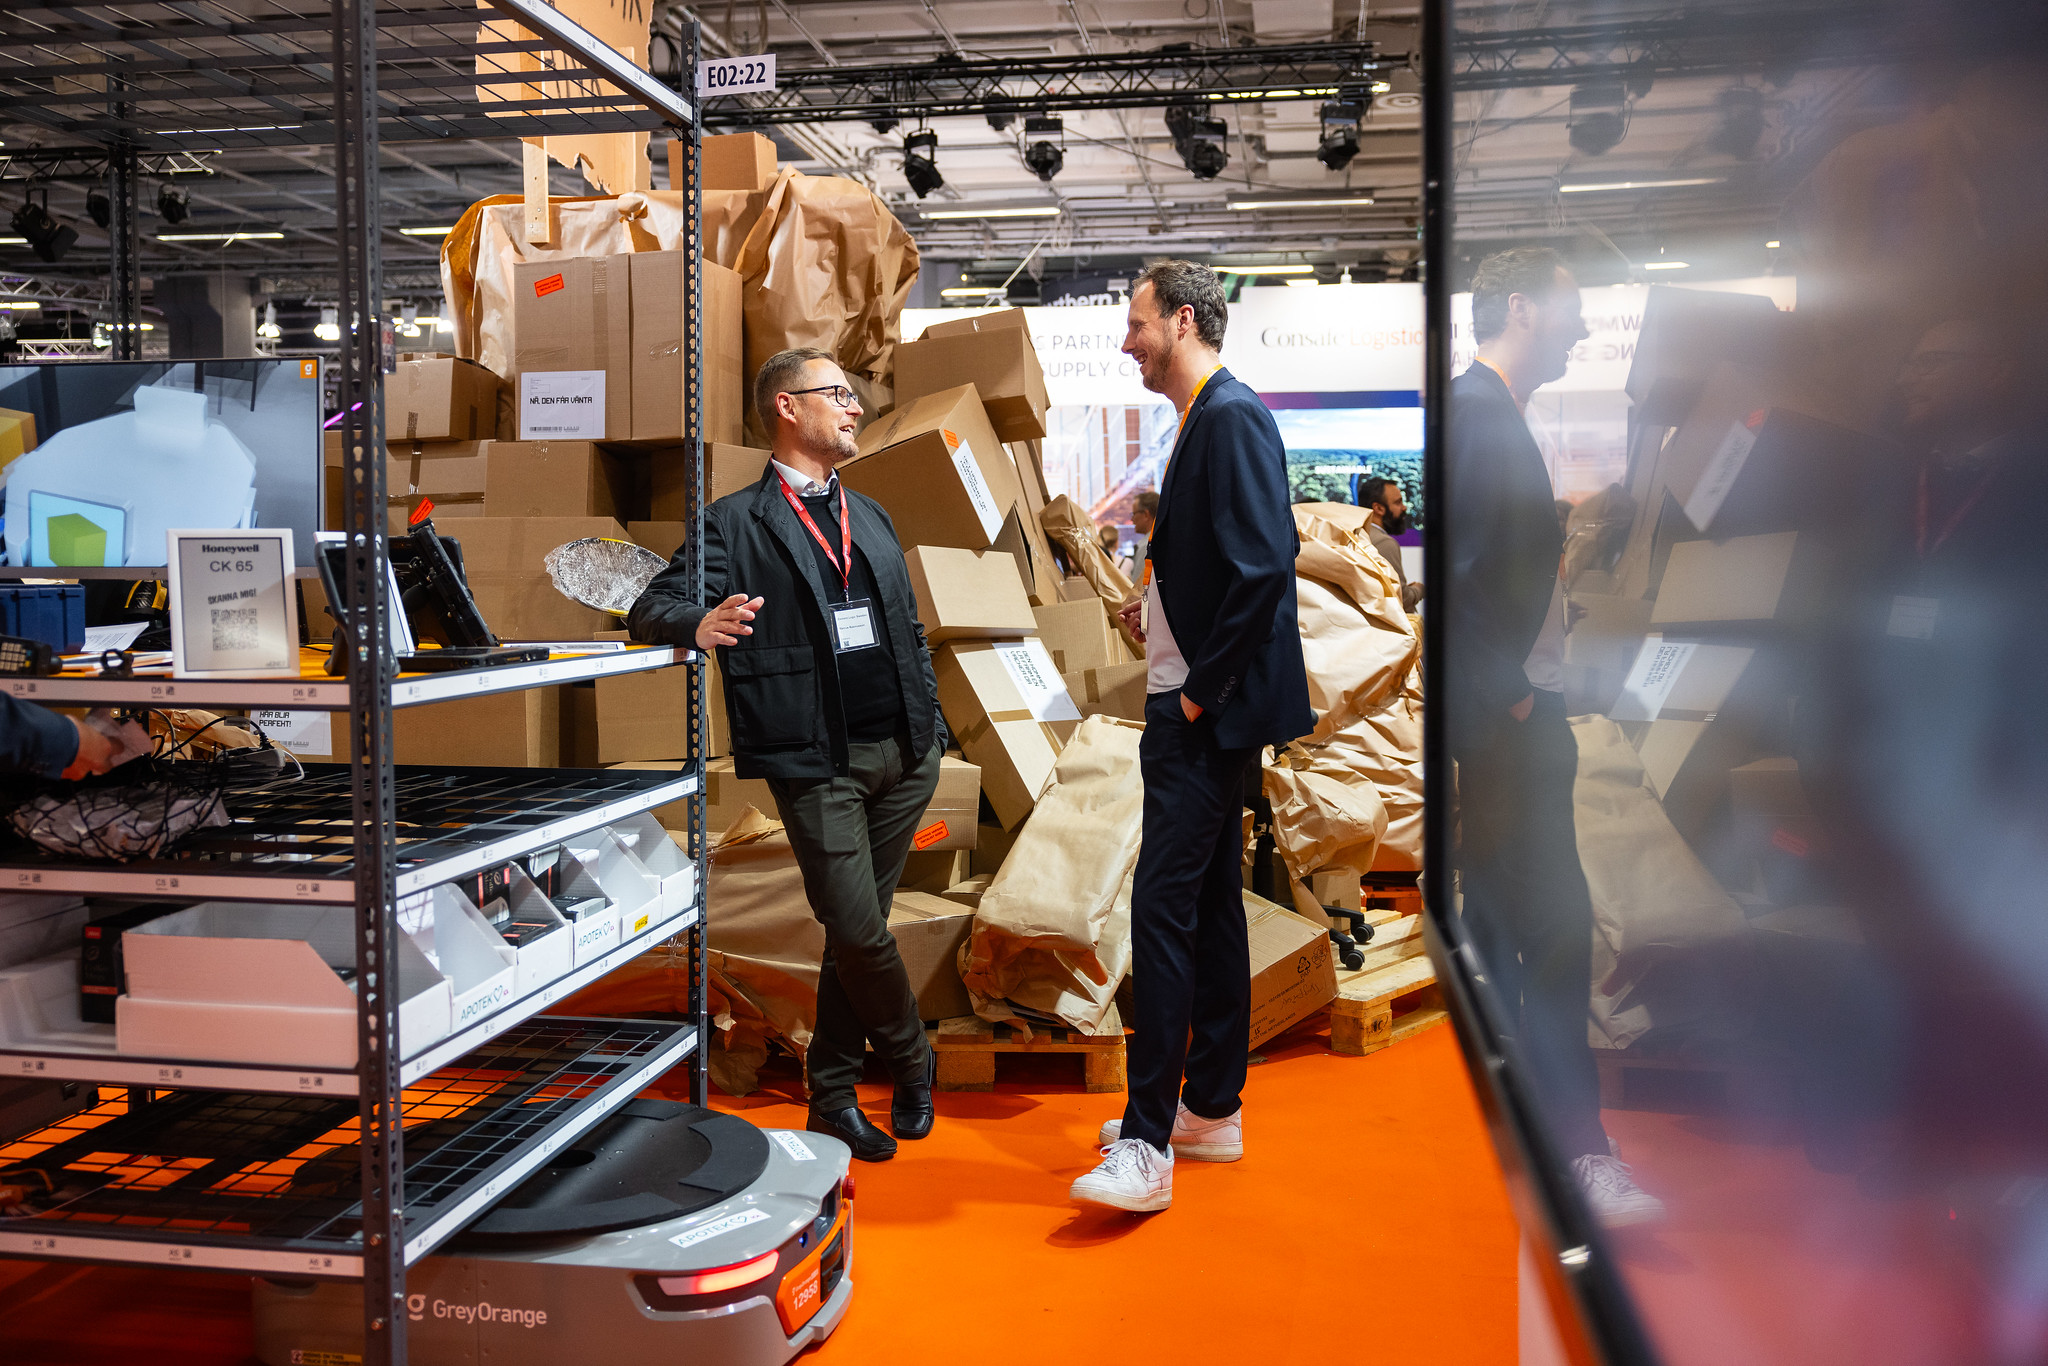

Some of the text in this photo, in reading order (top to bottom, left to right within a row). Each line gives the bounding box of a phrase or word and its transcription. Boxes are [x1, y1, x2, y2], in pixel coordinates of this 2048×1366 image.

[707, 62, 767, 89] E02:22
[1052, 334, 1126, 351] PARTN
[541, 396, 555, 405] DEN
[201, 543, 260, 555] Honeywell
[209, 560, 254, 573] CK 65
[207, 587, 257, 605] SKANNA MIG!
[578, 925, 603, 948] APOTEK
[459, 996, 493, 1024] APOTEK
[678, 1221, 731, 1247] APOTEK
[432, 1298, 548, 1329] GreyOrange
